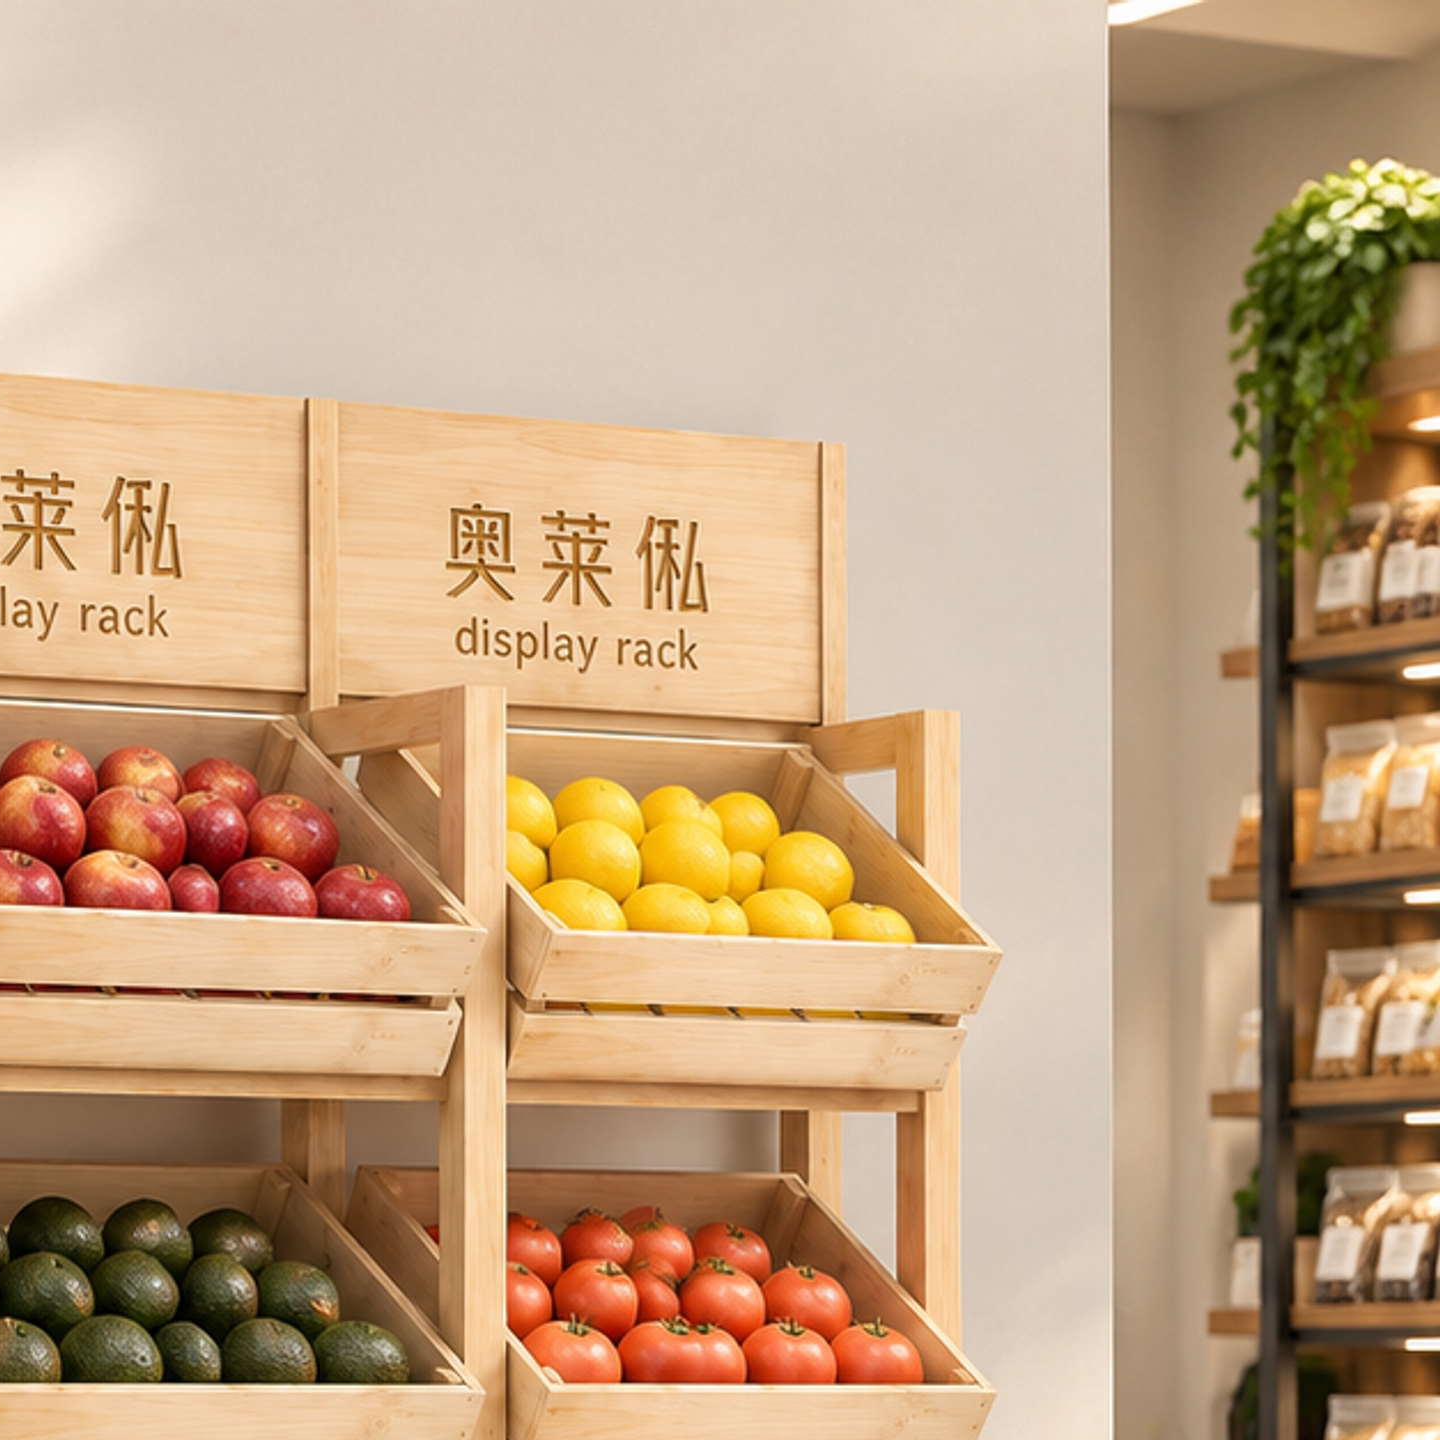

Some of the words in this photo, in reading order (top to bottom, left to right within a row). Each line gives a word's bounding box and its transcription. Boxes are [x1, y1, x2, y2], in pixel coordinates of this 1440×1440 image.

[79, 594, 169, 638] rack
[454, 616, 599, 674] display
[616, 628, 699, 670] rack
